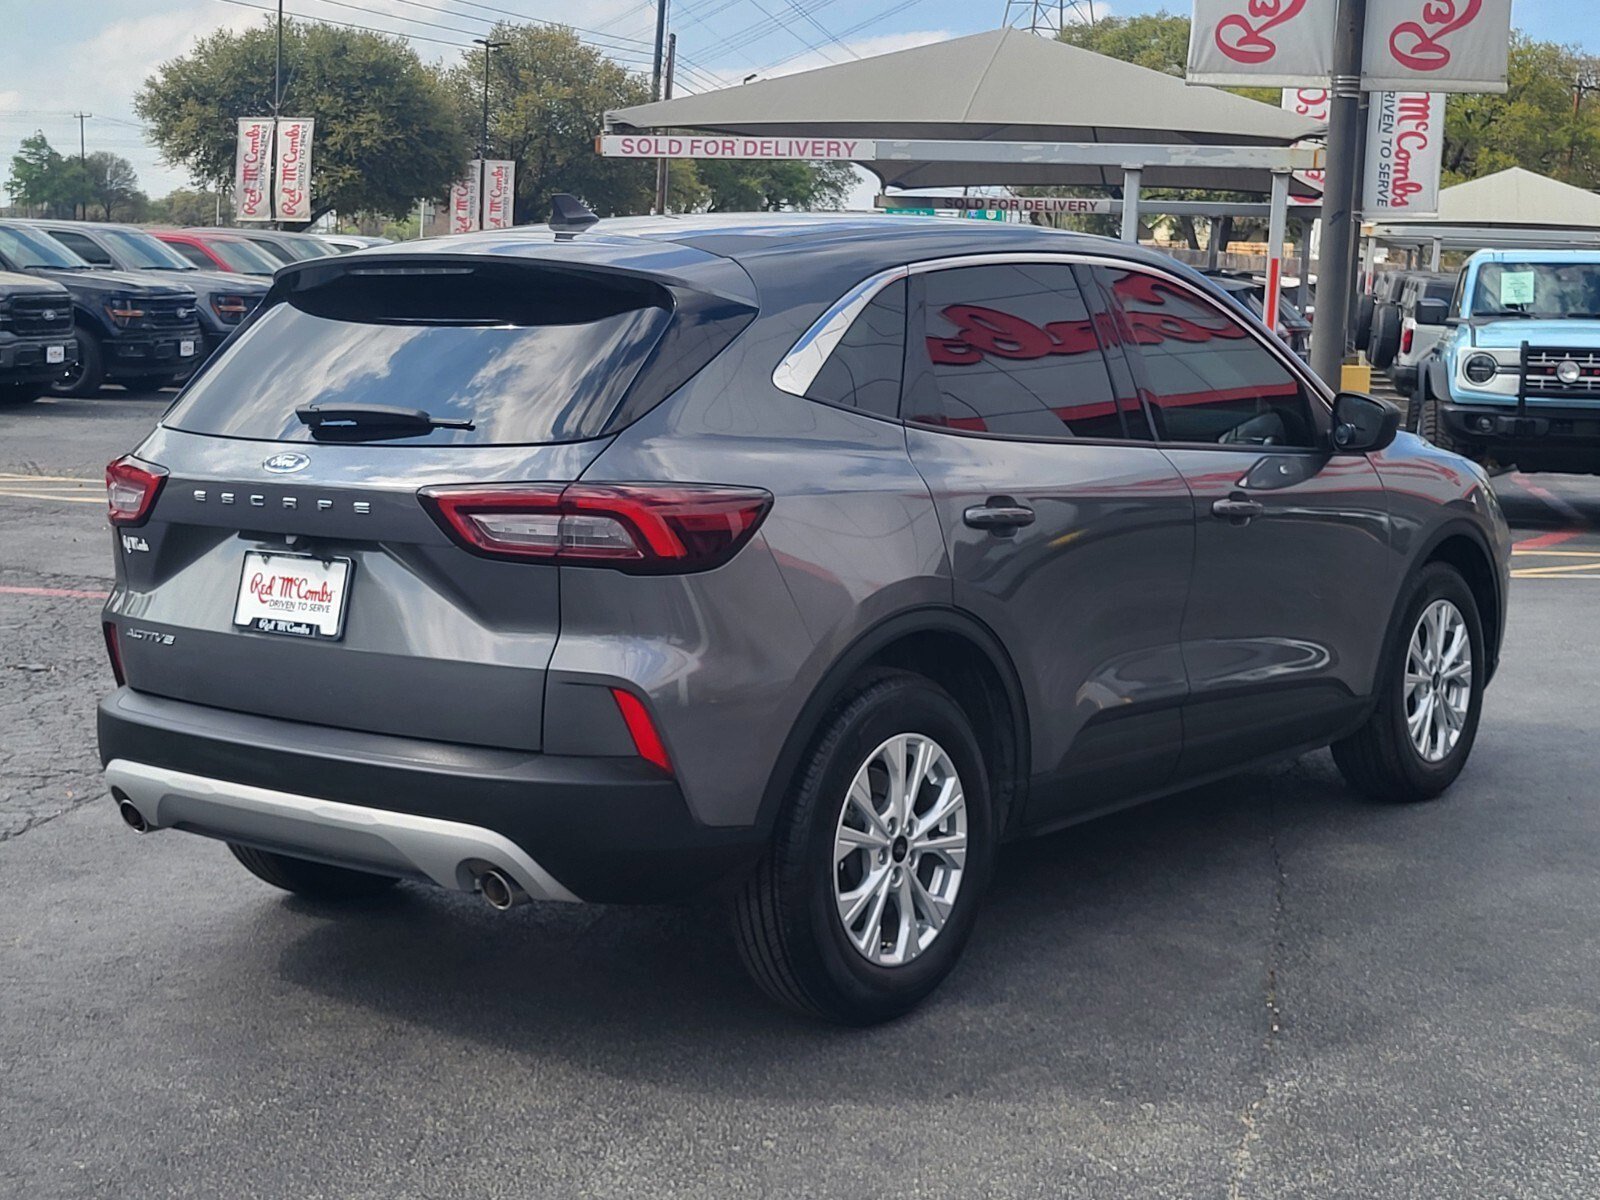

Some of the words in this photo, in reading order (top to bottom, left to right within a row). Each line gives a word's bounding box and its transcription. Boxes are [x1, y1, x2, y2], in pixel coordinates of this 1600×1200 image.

[1382, 91, 1396, 134] RIVEN
[243, 124, 260, 184] McCombs
[282, 124, 300, 184] McCombs
[621, 138, 682, 155] SOLD
[690, 140, 735, 156] FOR
[743, 140, 858, 157] DELIVERY
[1380, 138, 1392, 158] TO
[1391, 92, 1430, 207] McCombs
[1377, 163, 1391, 207] SERVE
[243, 188, 262, 215] Red
[282, 188, 302, 215] Red
[944, 198, 984, 210] SOLD
[989, 200, 1019, 211] FOR
[1024, 200, 1098, 212] DELIVERY
[194, 490, 370, 514] ESCAPE
[250, 572, 276, 604] Red
[279, 576, 333, 603] McCombs
[269, 599, 296, 610] DRIVEN
[298, 602, 308, 611] TO
[308, 604, 331, 613] SERVE
